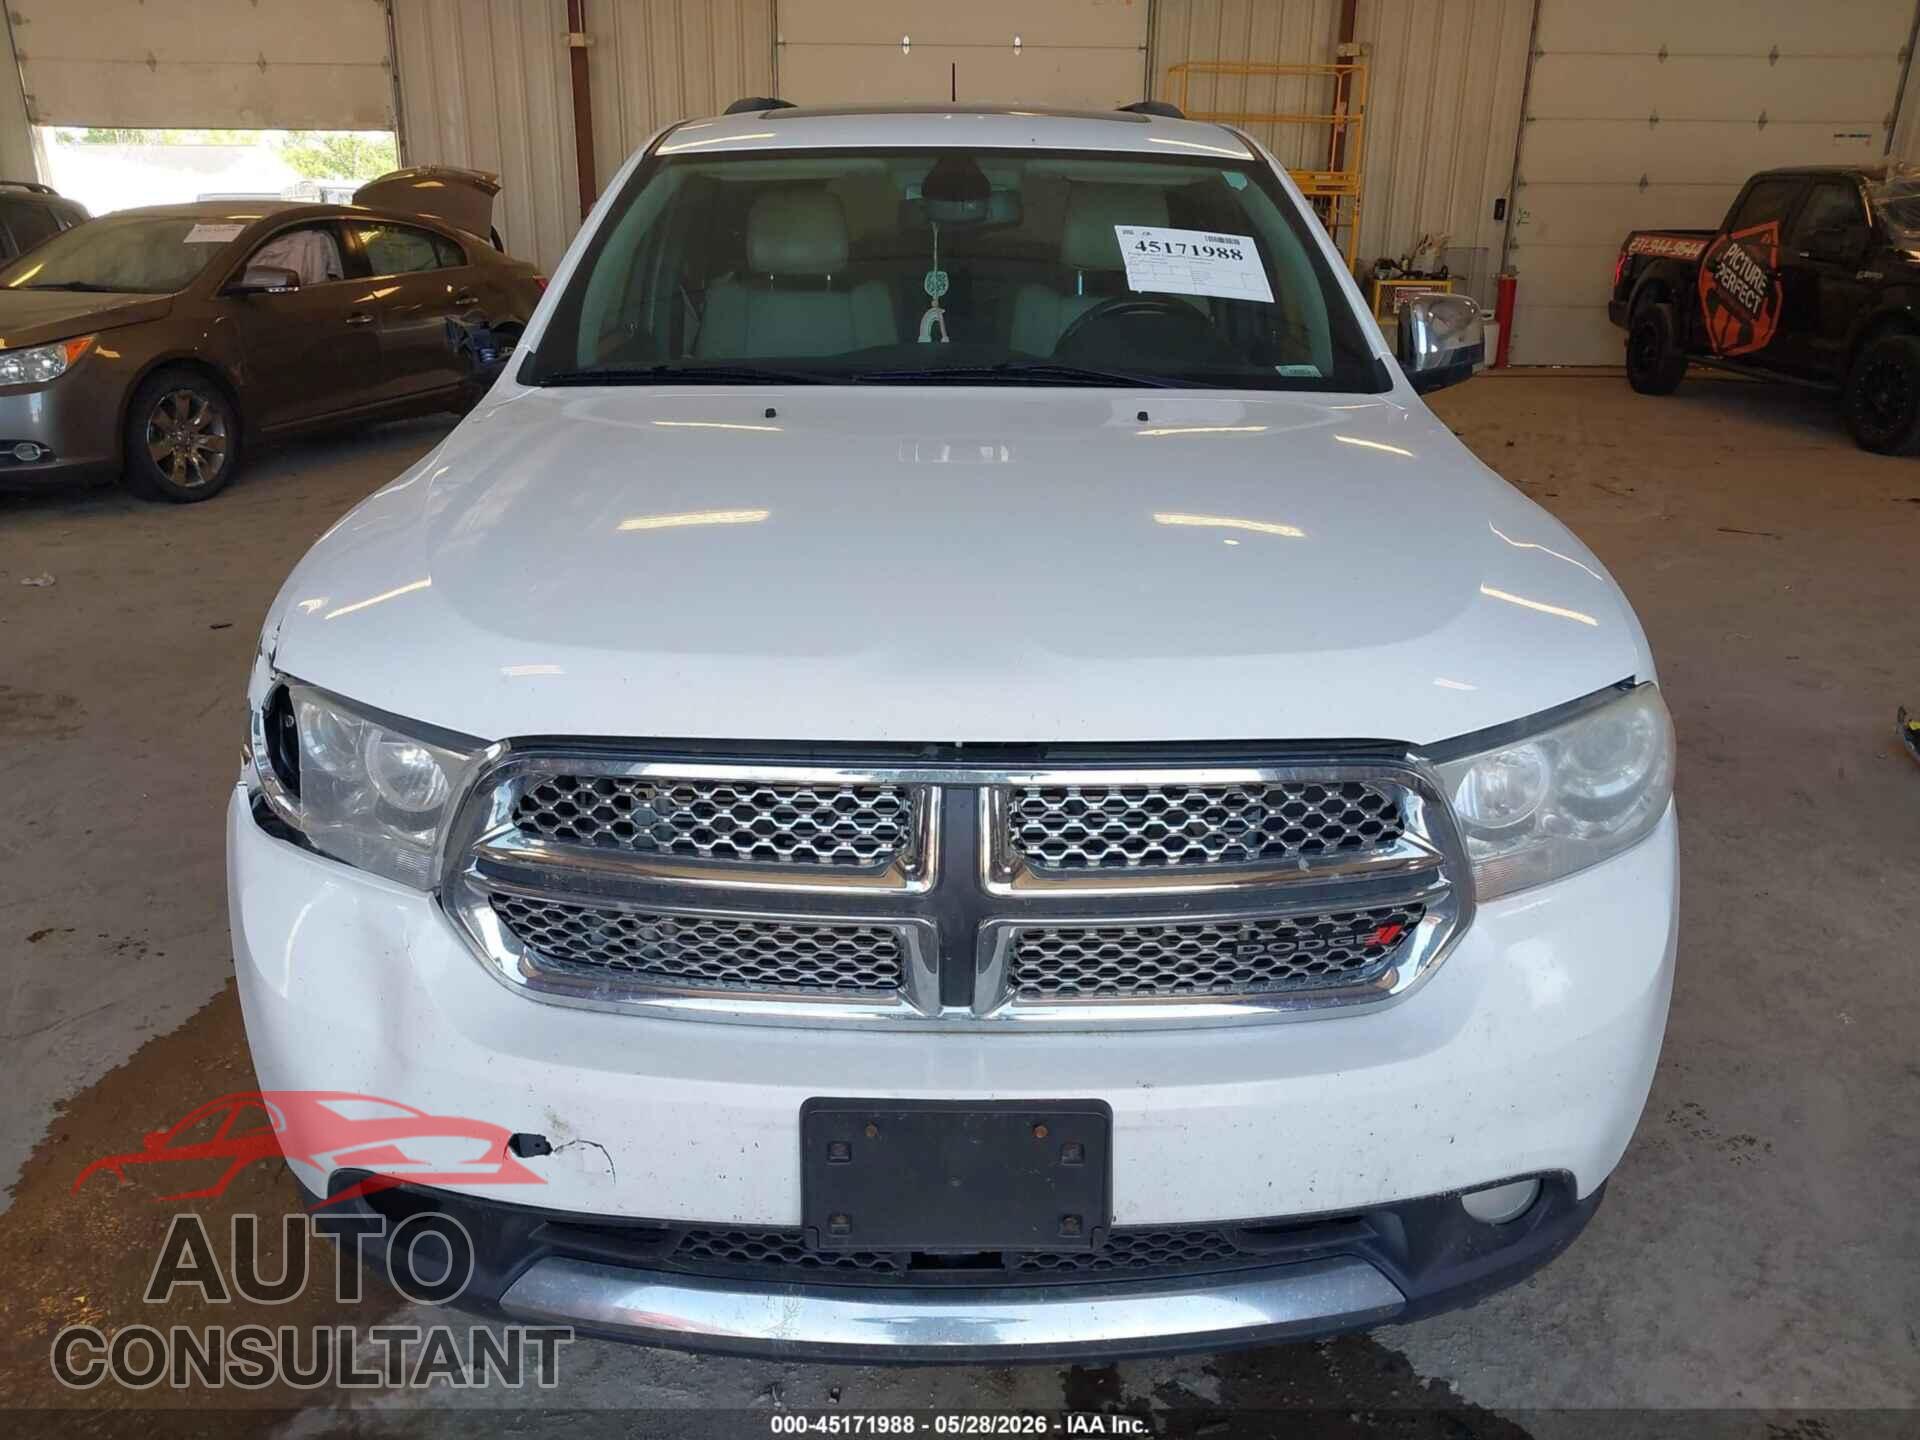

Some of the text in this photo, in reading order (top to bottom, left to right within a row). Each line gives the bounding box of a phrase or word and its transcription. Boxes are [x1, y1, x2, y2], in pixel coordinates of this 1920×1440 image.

[1134, 239, 1244, 261] 45171988
[1723, 242, 1768, 296] PICTURE
[1714, 262, 1762, 315] PERFECT
[1237, 935, 1376, 955] DODGE
